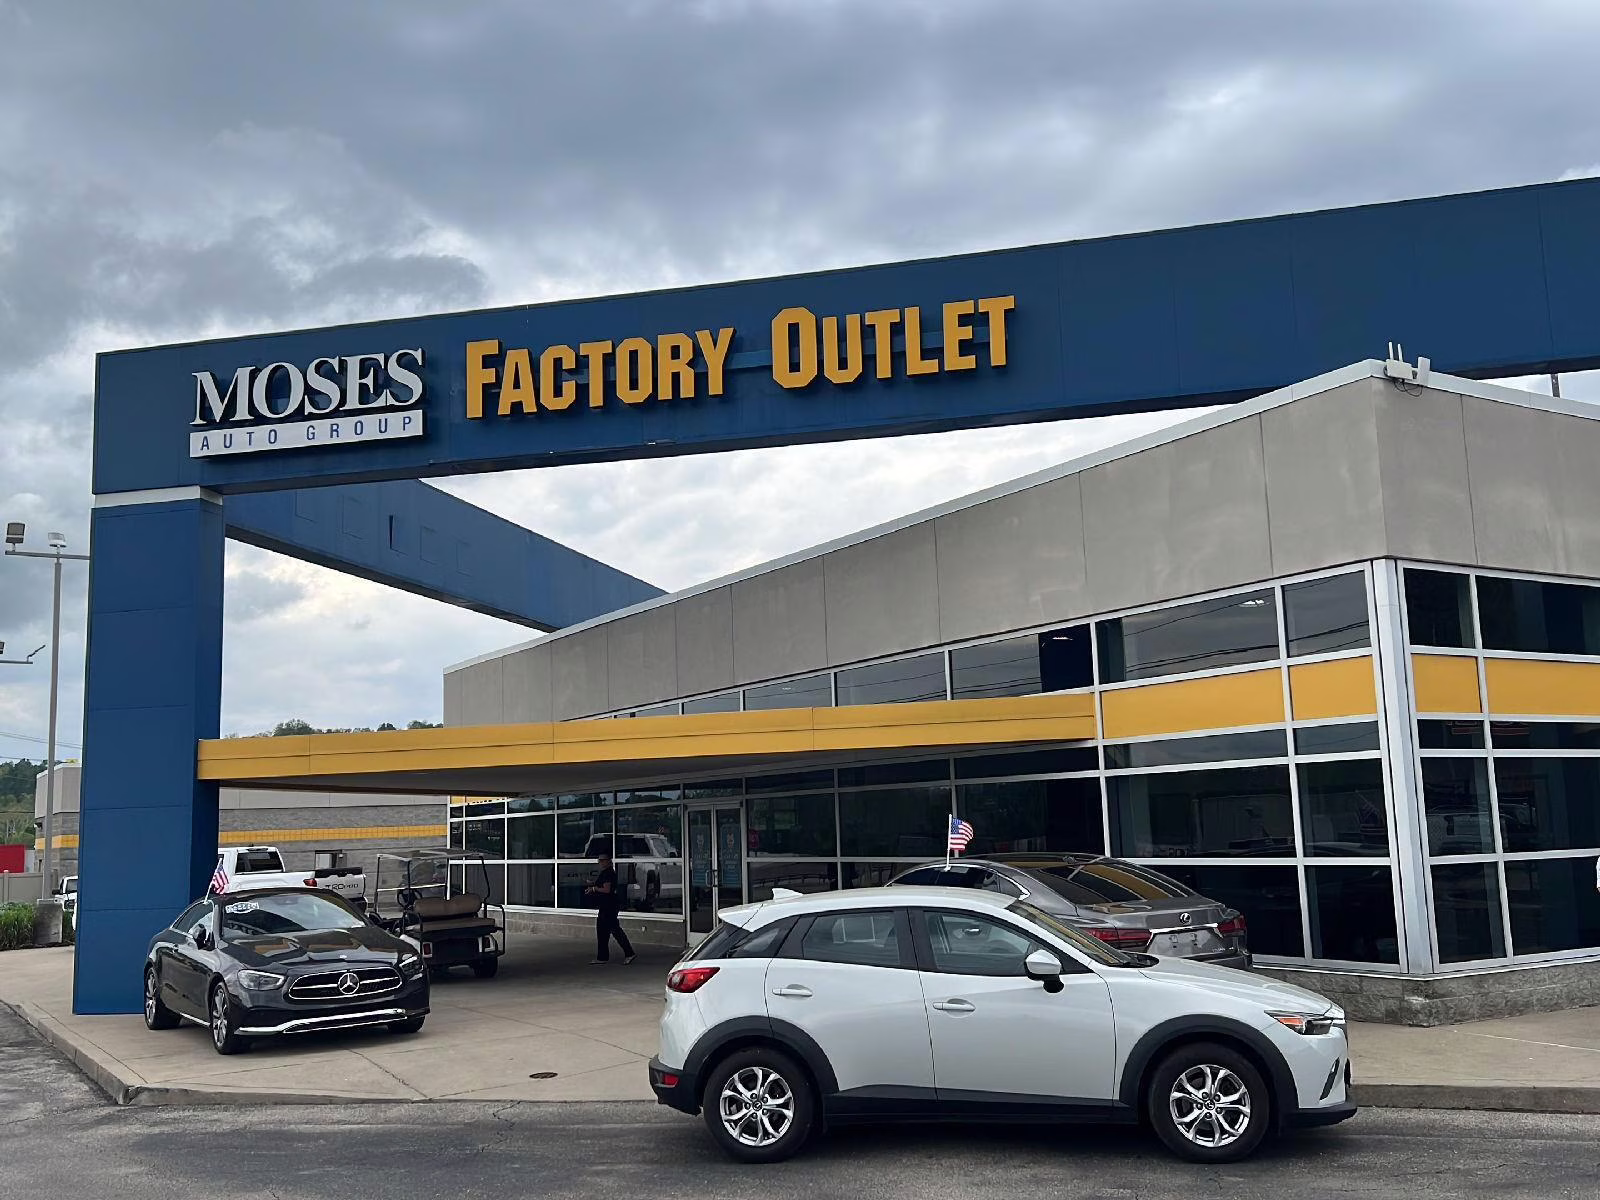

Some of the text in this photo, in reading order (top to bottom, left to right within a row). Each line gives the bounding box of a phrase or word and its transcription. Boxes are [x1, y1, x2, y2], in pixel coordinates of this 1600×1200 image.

[190, 347, 424, 425] MOSES
[466, 295, 1016, 418] FACTORY OUTLET
[201, 415, 412, 451] AUTO GROUP
